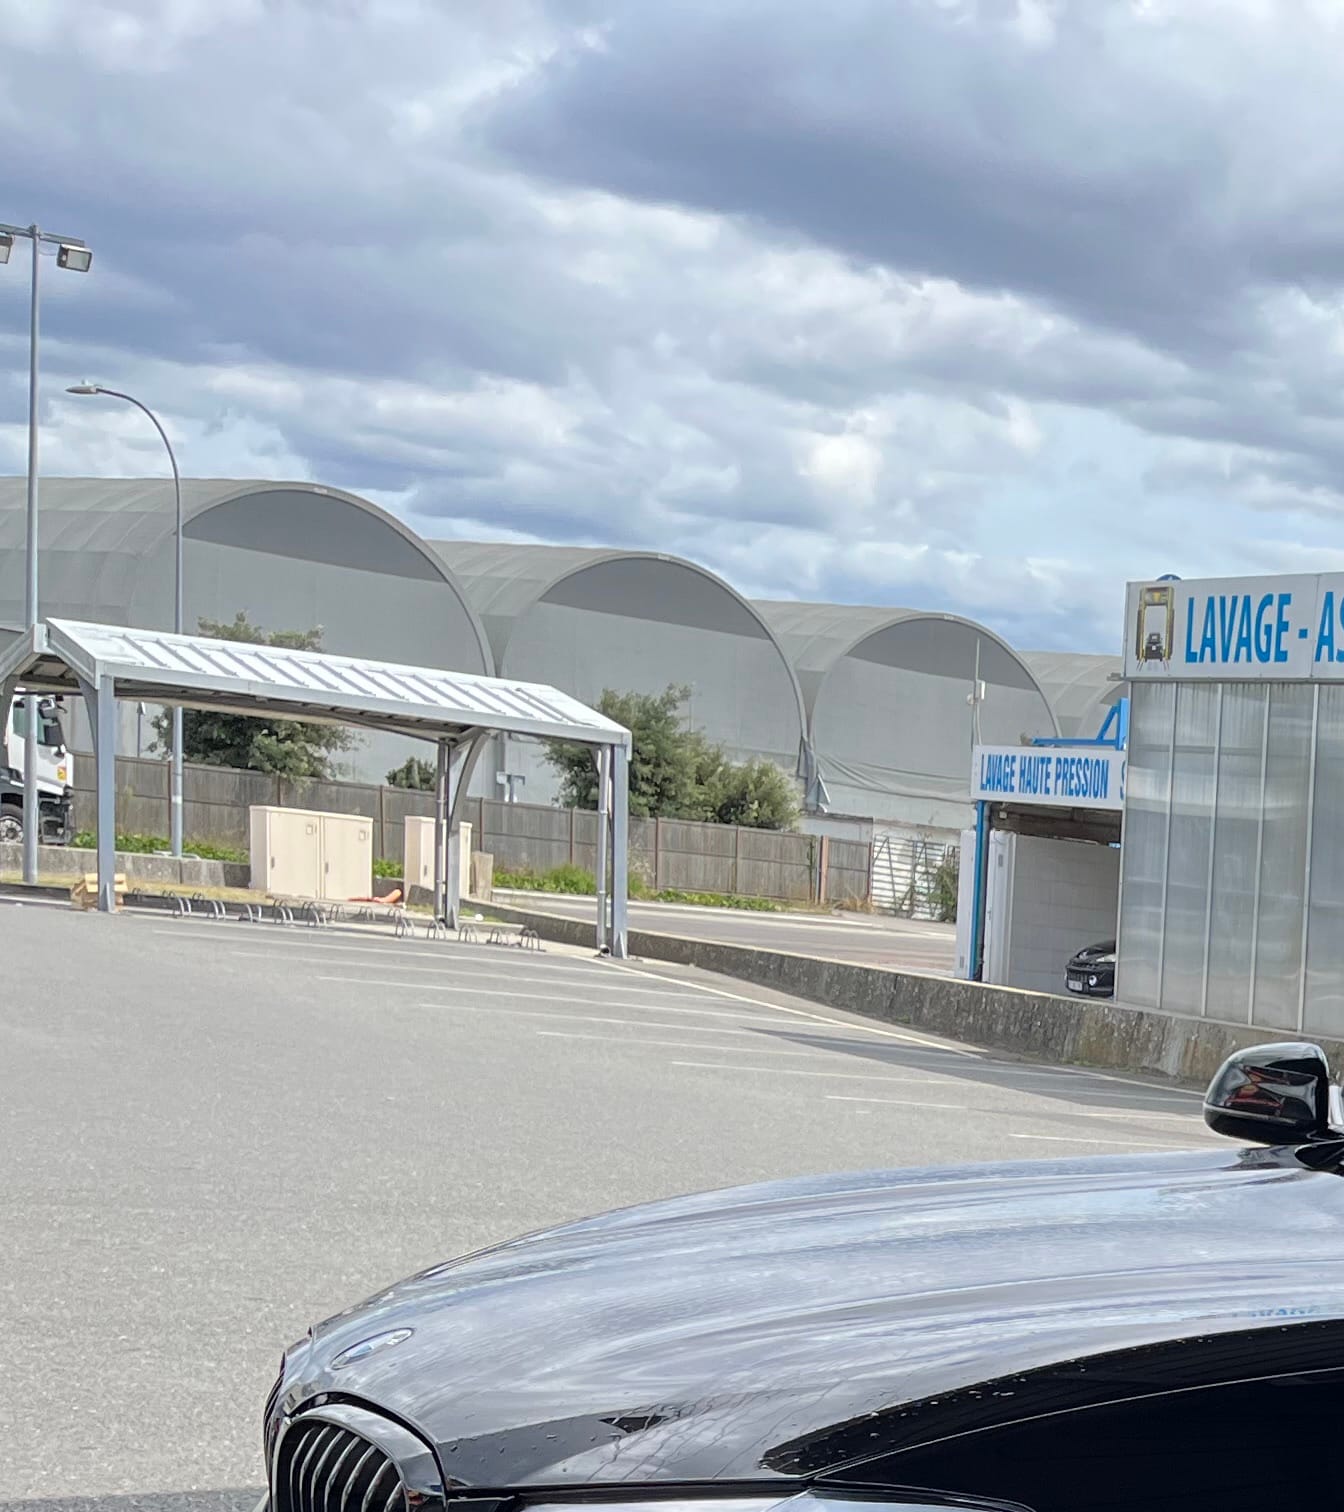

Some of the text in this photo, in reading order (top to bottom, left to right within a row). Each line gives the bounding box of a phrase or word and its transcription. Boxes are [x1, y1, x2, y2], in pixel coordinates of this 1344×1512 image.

[1185, 593, 1292, 663] LAVAGE
[980, 754, 1016, 792] LAVAGE
[1019, 755, 1052, 795] HAUTE
[1054, 756, 1109, 799] PRESSION
